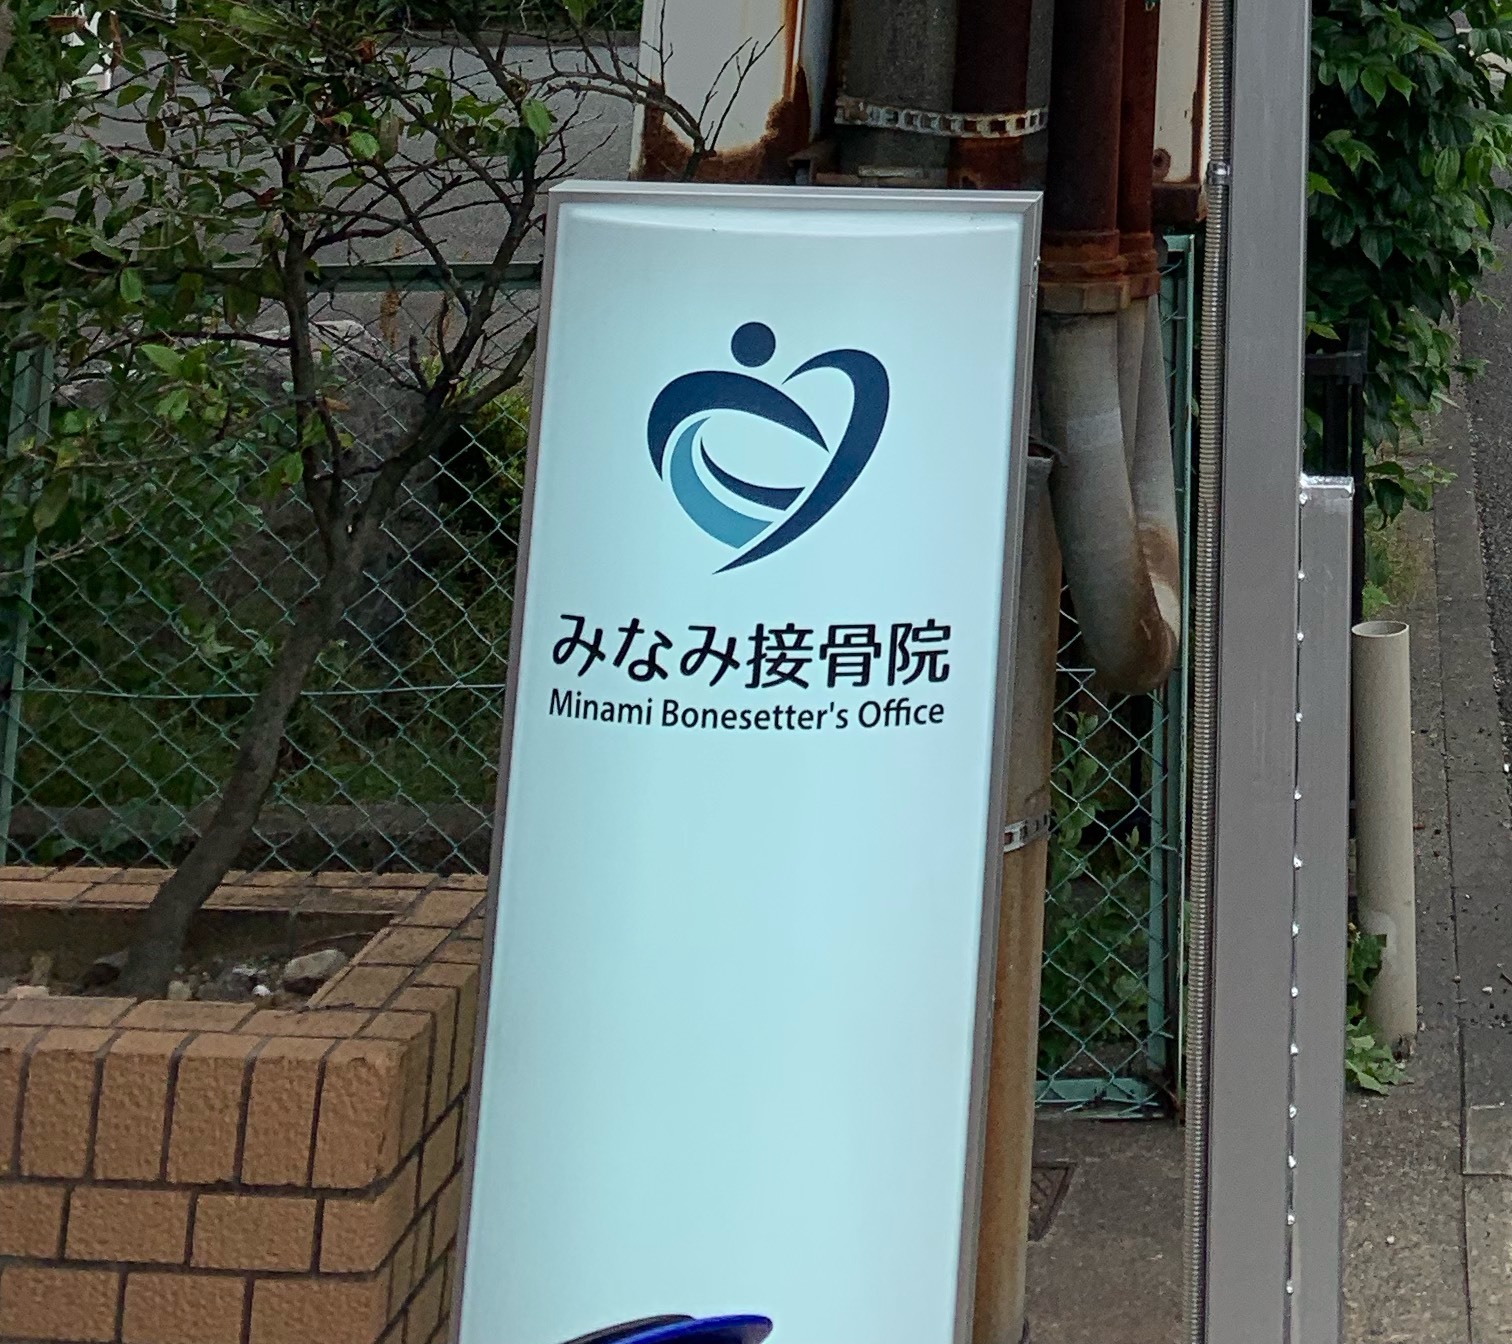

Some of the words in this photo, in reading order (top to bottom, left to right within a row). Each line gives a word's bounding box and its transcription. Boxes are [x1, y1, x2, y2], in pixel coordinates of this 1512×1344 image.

[552, 612, 952, 690] みなみ接骨院
[548, 688, 654, 727] Minami
[661, 698, 849, 730] Bonesetter's
[857, 696, 946, 729] Office
